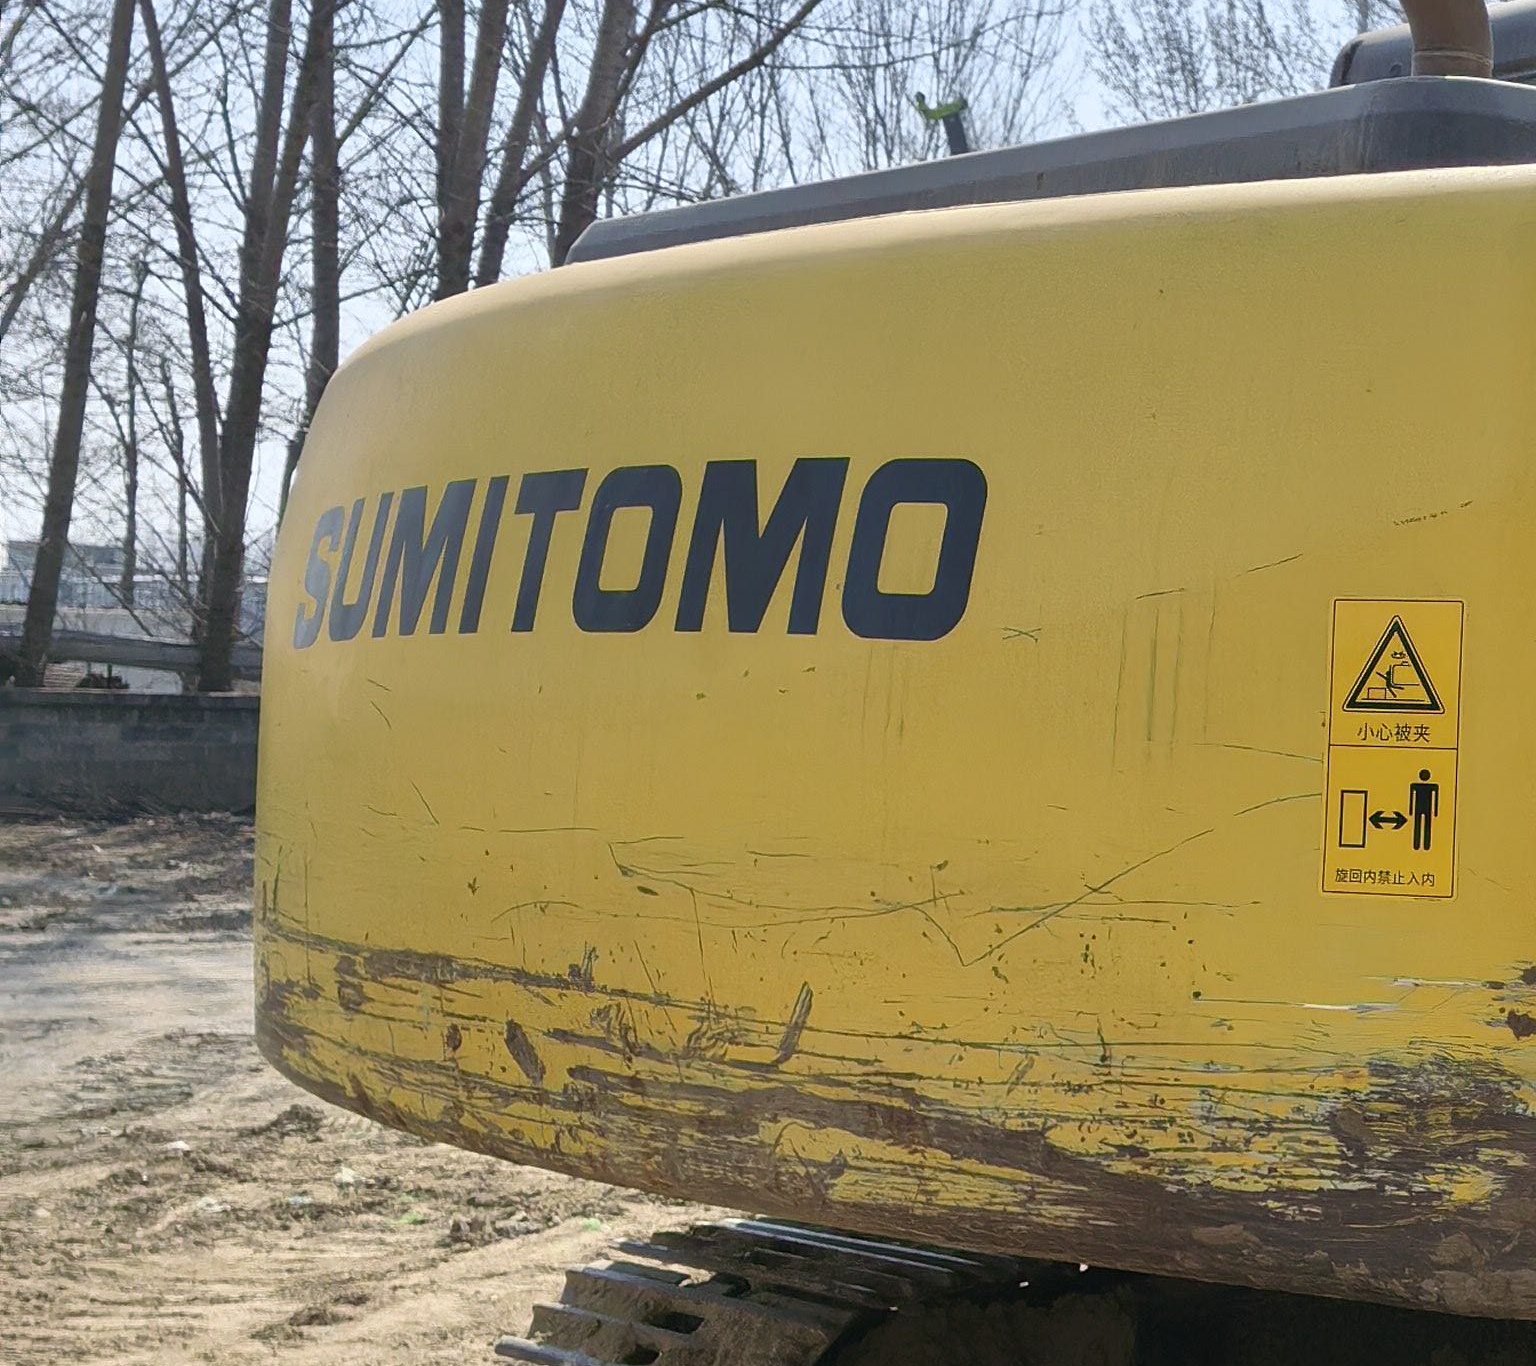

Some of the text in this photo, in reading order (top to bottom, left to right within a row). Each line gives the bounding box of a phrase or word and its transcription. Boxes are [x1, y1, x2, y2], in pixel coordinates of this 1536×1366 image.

[292, 456, 989, 648] SUMITOMO
[1357, 722, 1431, 743] 小心被夹
[1334, 867, 1436, 888] 旋回内禁止入内
